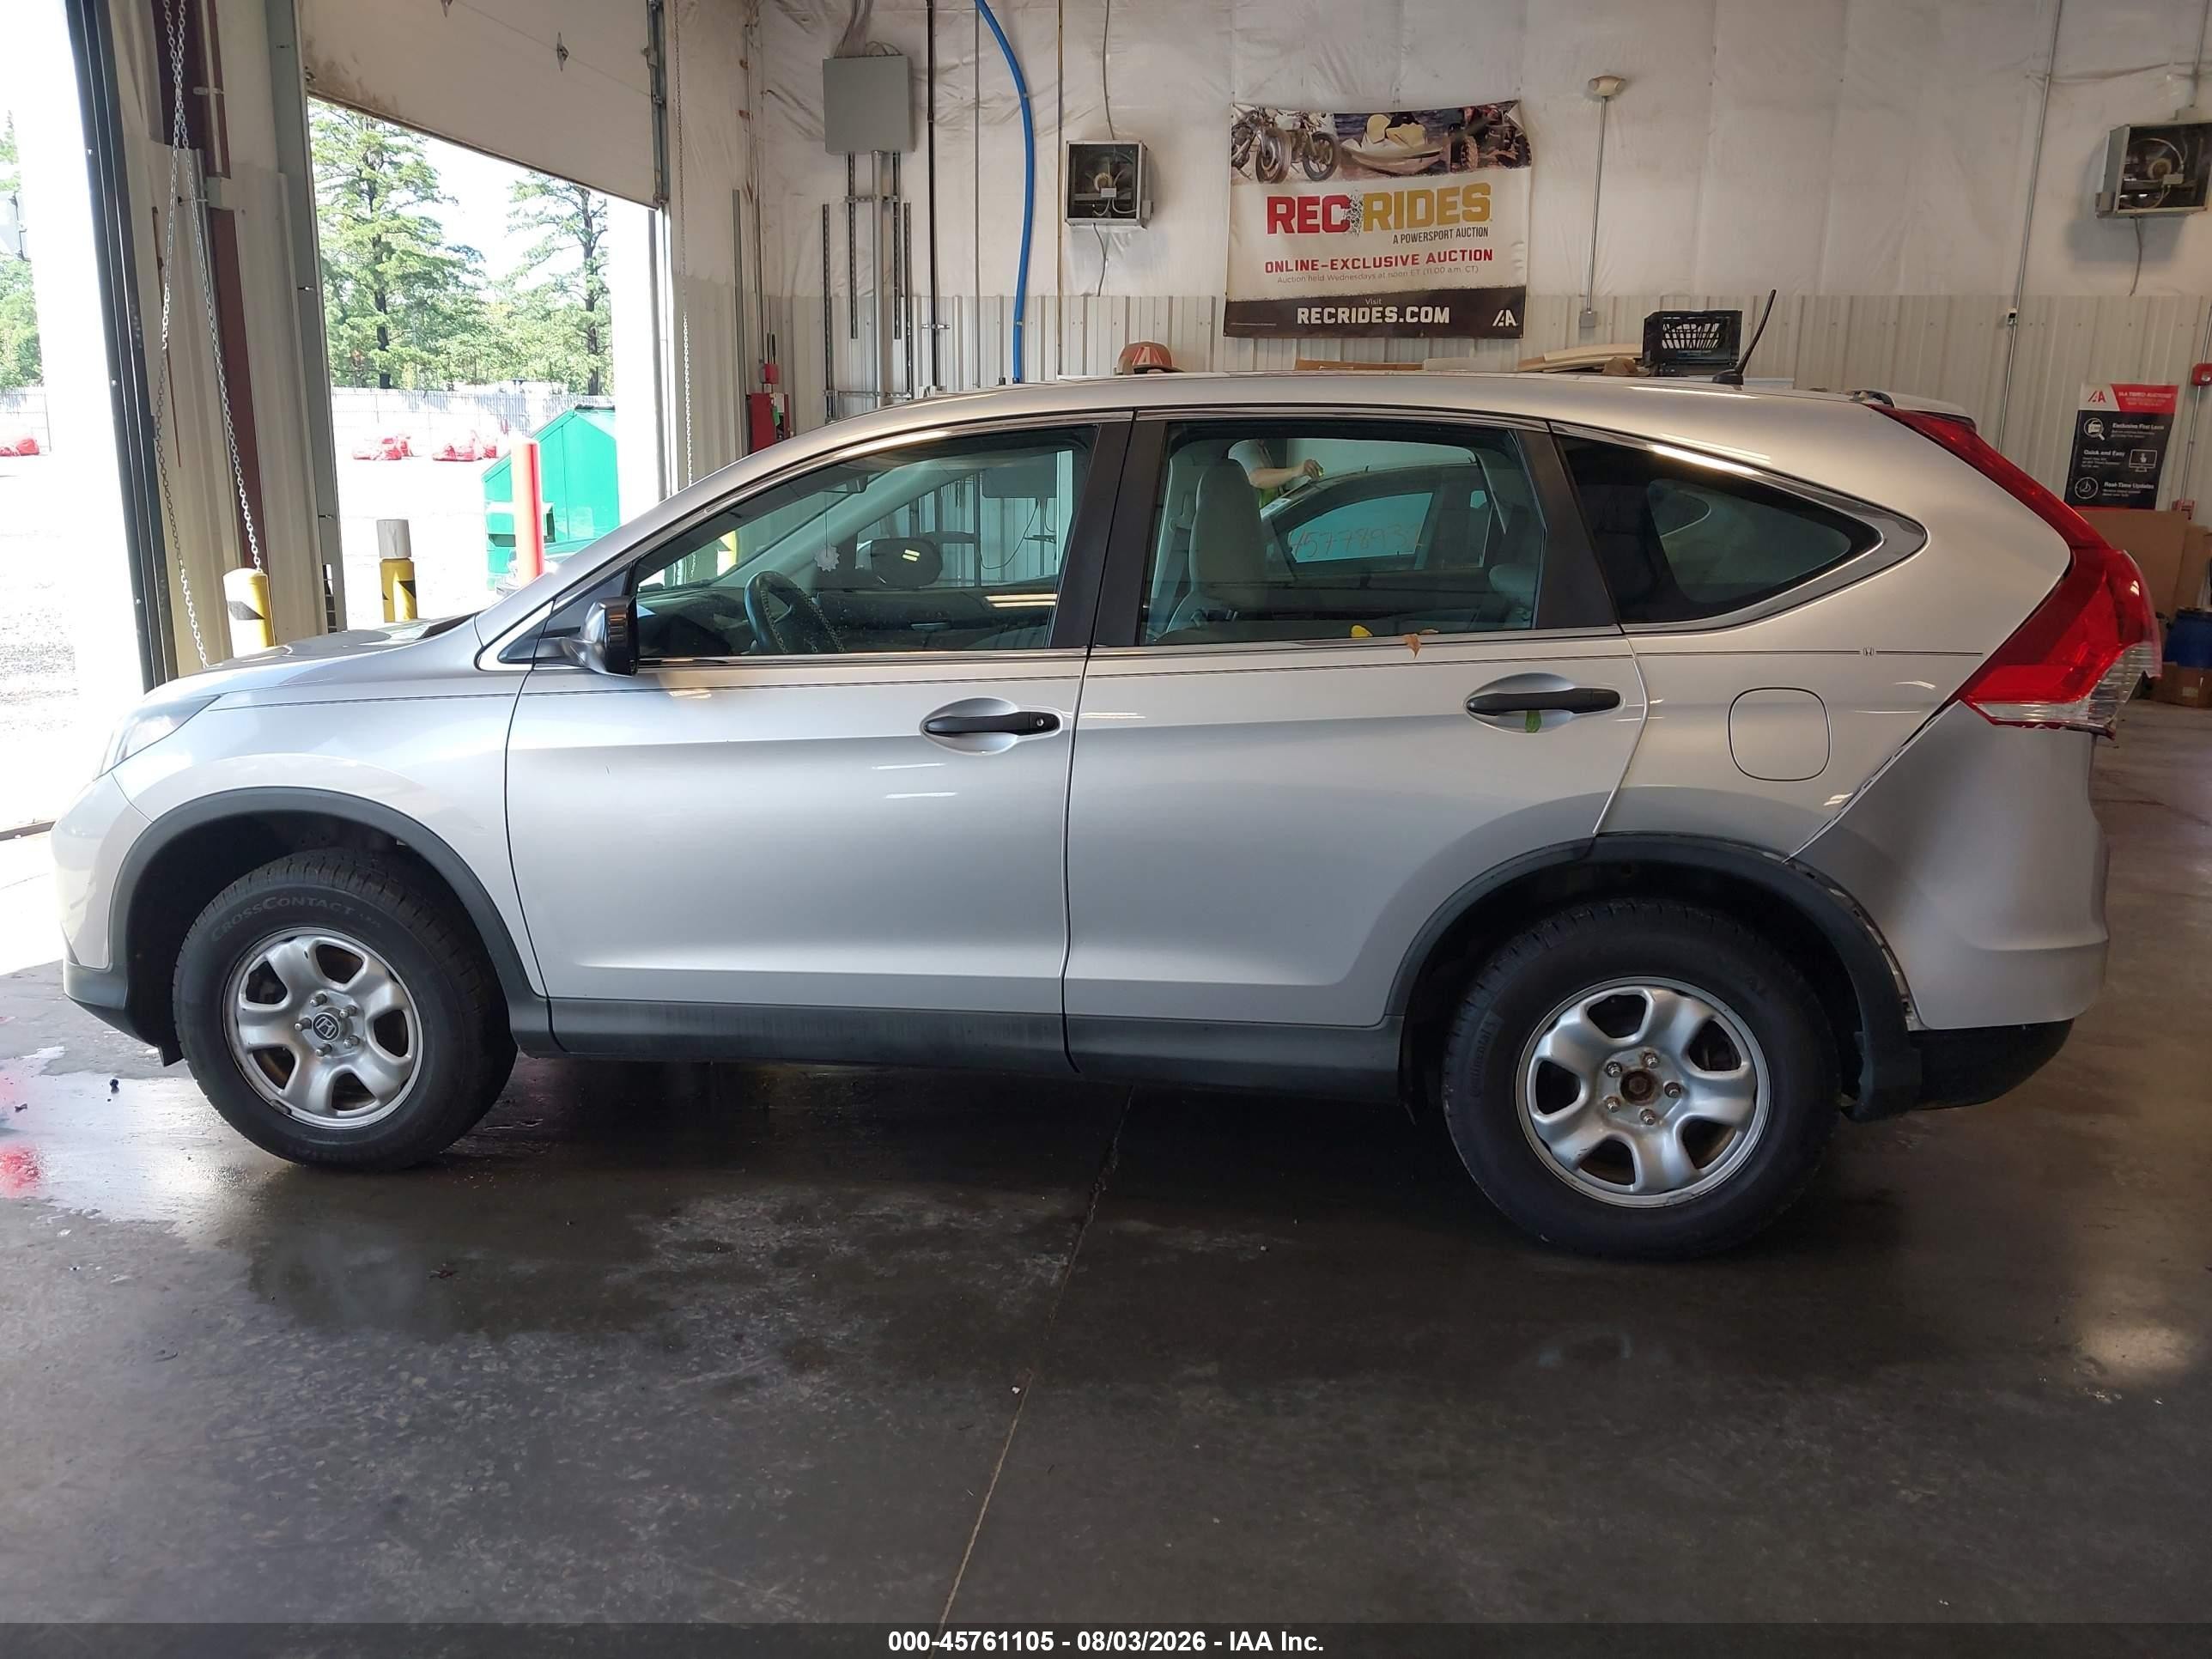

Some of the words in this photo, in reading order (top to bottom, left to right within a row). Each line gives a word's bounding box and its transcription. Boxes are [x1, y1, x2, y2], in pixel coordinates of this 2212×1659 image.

[1267, 194, 1353, 234] REC
[1363, 182, 1492, 232] RIDES
[1393, 234, 1399, 244] A
[1400, 228, 1454, 244] POWERSPORT
[1455, 227, 1489, 239] AUCTION
[1265, 253, 1419, 274] ONLINE-EXCLUSIVE
[1425, 249, 1493, 264] AUCTION
[1277, 275, 1305, 283] Auction
[1328, 272, 1375, 283] Wednesdays
[1365, 297, 1382, 306] Visit
[1297, 306, 1450, 325] RECRIDES.COM
